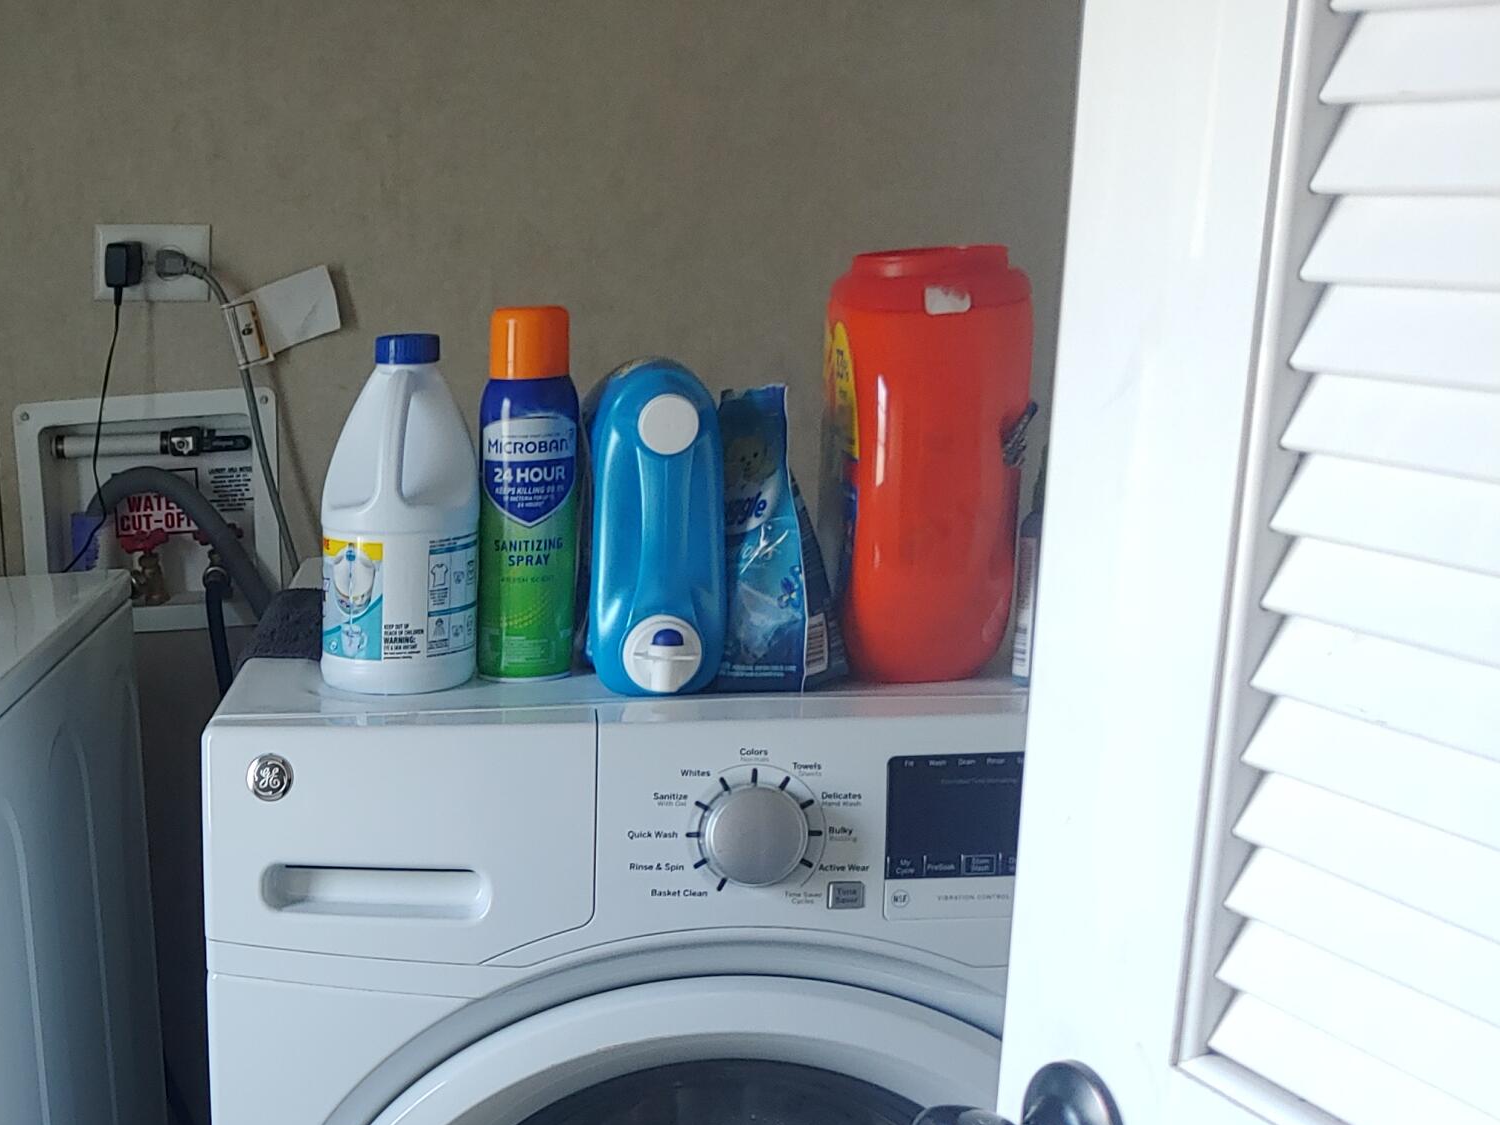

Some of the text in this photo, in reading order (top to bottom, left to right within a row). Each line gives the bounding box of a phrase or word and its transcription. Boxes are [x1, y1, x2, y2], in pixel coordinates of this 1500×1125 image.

[488, 438, 569, 454] MICROBAN
[494, 464, 566, 484] 24 HOUR
[516, 485, 546, 494] KILLING
[126, 493, 181, 513] WATE
[494, 537, 564, 552] SANITIZING
[508, 553, 550, 567] SPRAY
[384, 636, 416, 644] WARNING:
[740, 747, 768, 756] Colors
[792, 761, 822, 770] Towels
[680, 768, 711, 777] Whites
[653, 792, 688, 801] Sanitize
[822, 791, 862, 800] Delicates
[627, 830, 678, 840] Quick Wash
[828, 826, 854, 836] Bulky
[629, 862, 685, 873] Rinse & Spin
[819, 863, 870, 872] Active Wear
[650, 888, 708, 898] Basket Clean
